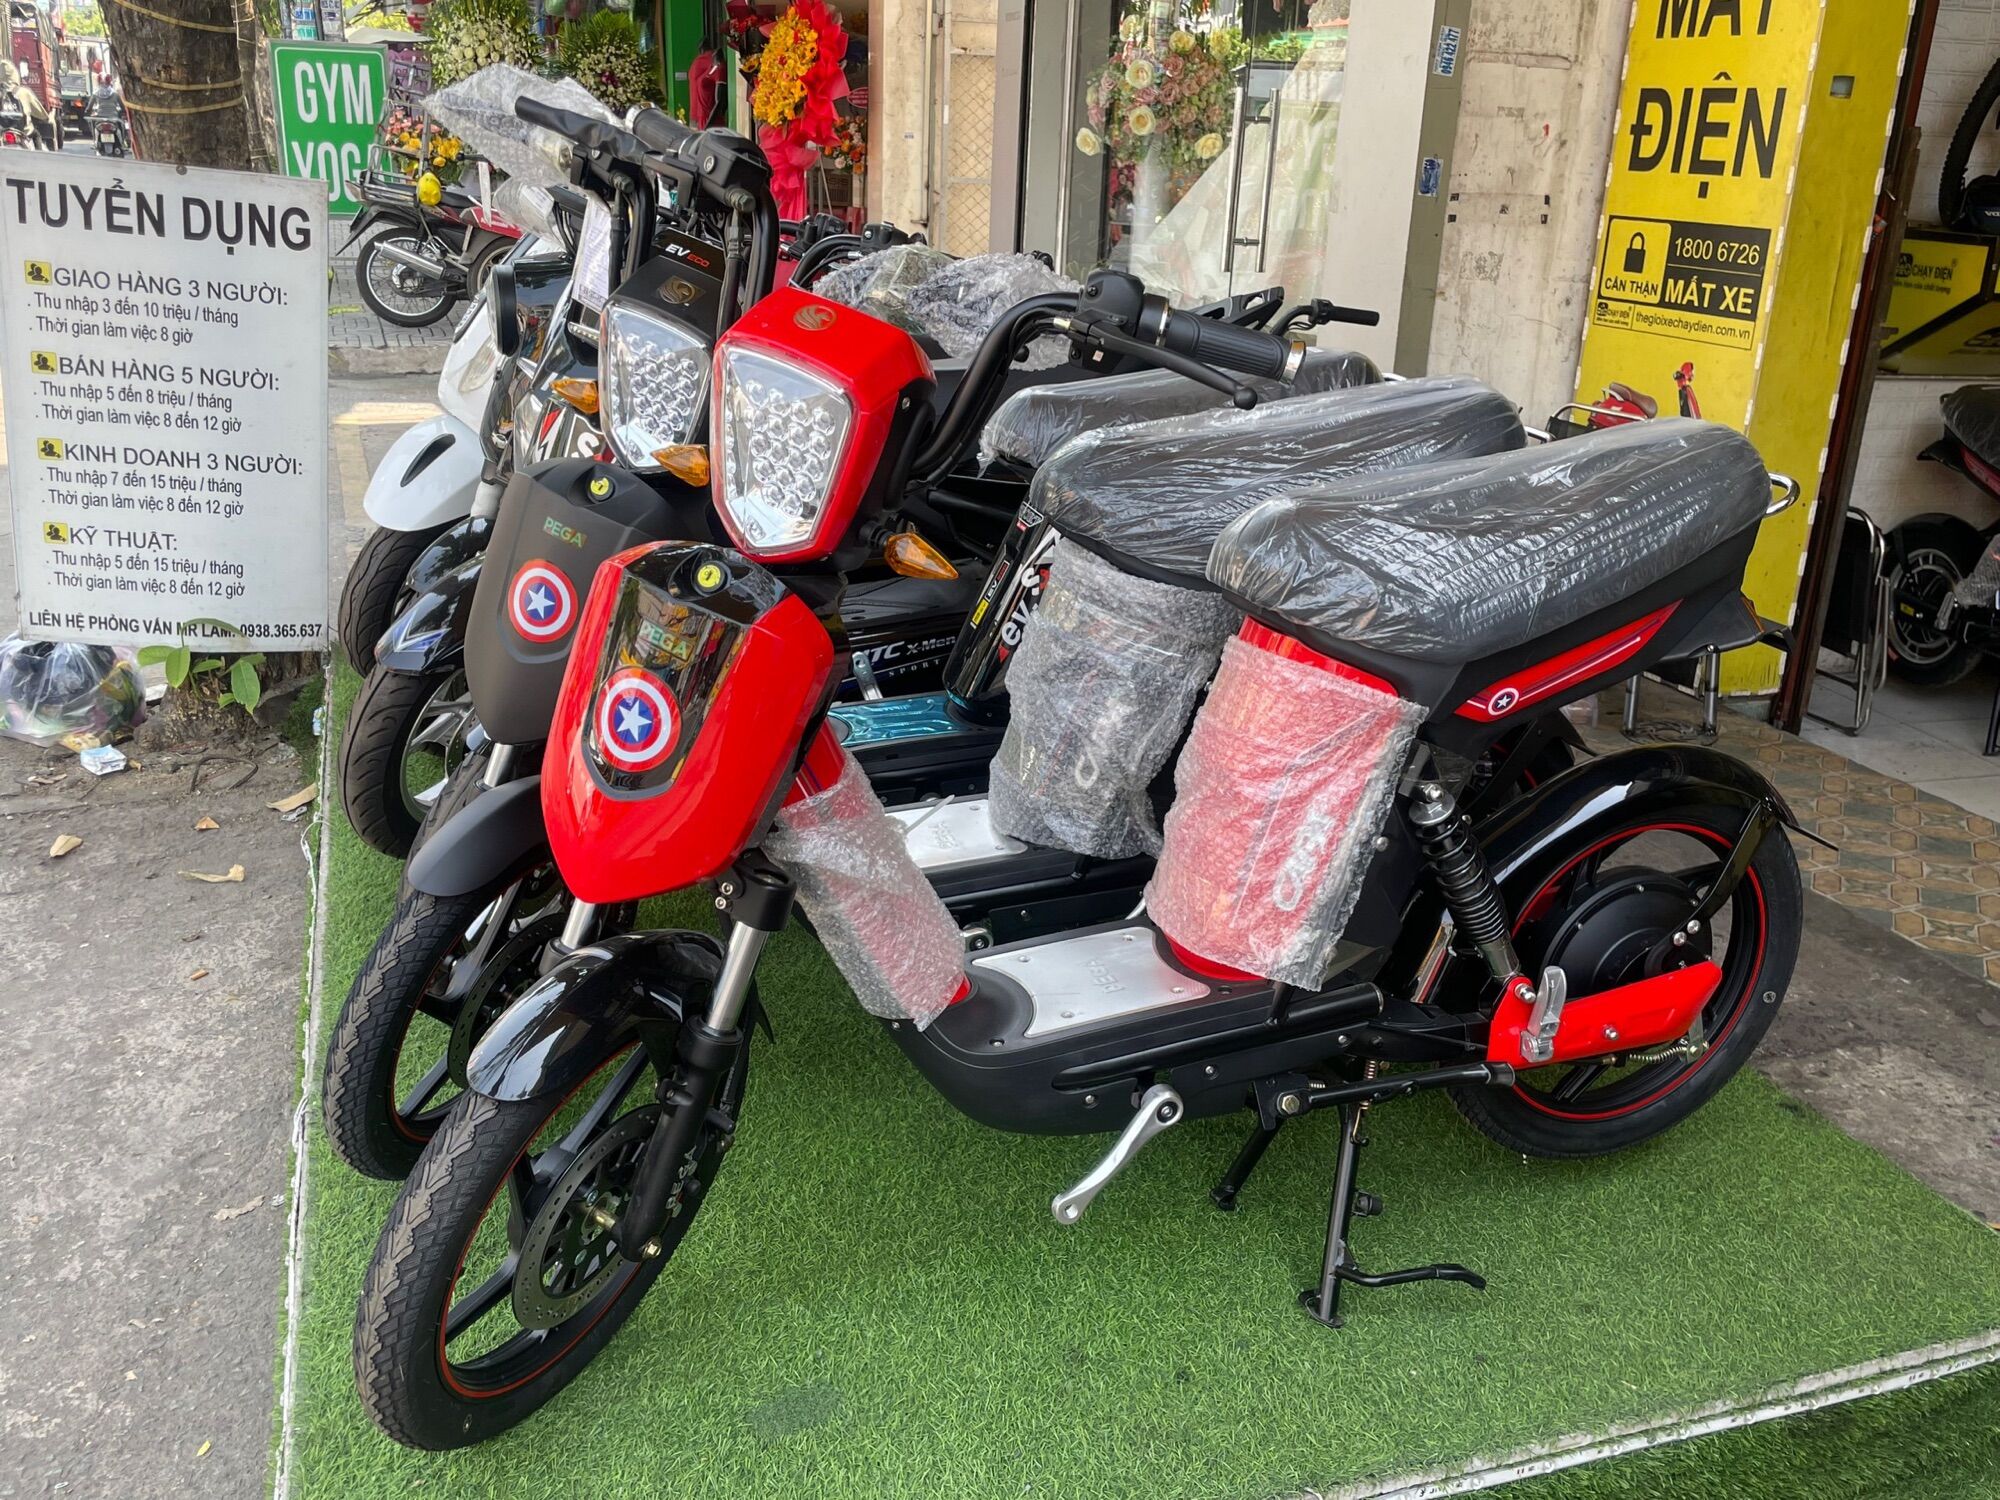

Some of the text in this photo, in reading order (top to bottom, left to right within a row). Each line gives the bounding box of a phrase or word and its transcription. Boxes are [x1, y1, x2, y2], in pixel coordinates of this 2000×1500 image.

[294, 61, 374, 125] GYM
[1628, 71, 1788, 199] ĐIỆN
[6, 177, 311, 255] TUYỂN DỤNG
[665, 243, 710, 267] EV ECO
[1675, 237, 1760, 266] 1800 6726
[54, 267, 287, 306] GIAO HÀNG 3 NGƯỜI:
[1629, 281, 1658, 298] THẬN
[1664, 275, 1755, 314] MẤT XE
[34, 291, 239, 328] Thu nhập 3 đến 10 triệu / tháng
[36, 315, 193, 345] Thời gian làm việc 8 giờ
[1635, 312, 1751, 340] thegioixechaydien.com.vn
[60, 355, 279, 390] BÁN HÀNG 5 NGƯỜI:
[40, 381, 232, 413] Thu nhập 5 đến 8 triệu / tháng
[42, 403, 241, 435] Thời gian làm việc 8 đến 12 giờ
[65, 443, 303, 475] KINH DOANH 3 NGƯỜI:
[47, 467, 242, 498] Thu nhập 7 đến 15 triệu / tháng
[49, 489, 244, 520] Thời gian làm việc 8 đến 12 giờ
[71, 525, 177, 553] KỸ THUẬT:
[543, 516, 582, 548] PEGA
[53, 550, 244, 579] Thu nhập 5 đến 15 triệu / tháng
[54, 571, 245, 600] Thời gian làm việc 8 đến 12 giờ
[29, 609, 61, 627] LIÊN
[65, 612, 85, 632] HỆ
[176, 621, 198, 637] MR
[240, 624, 323, 638] 0938.365.637
[639, 619, 688, 661] PEGA
[889, 659, 941, 677] SPORT
